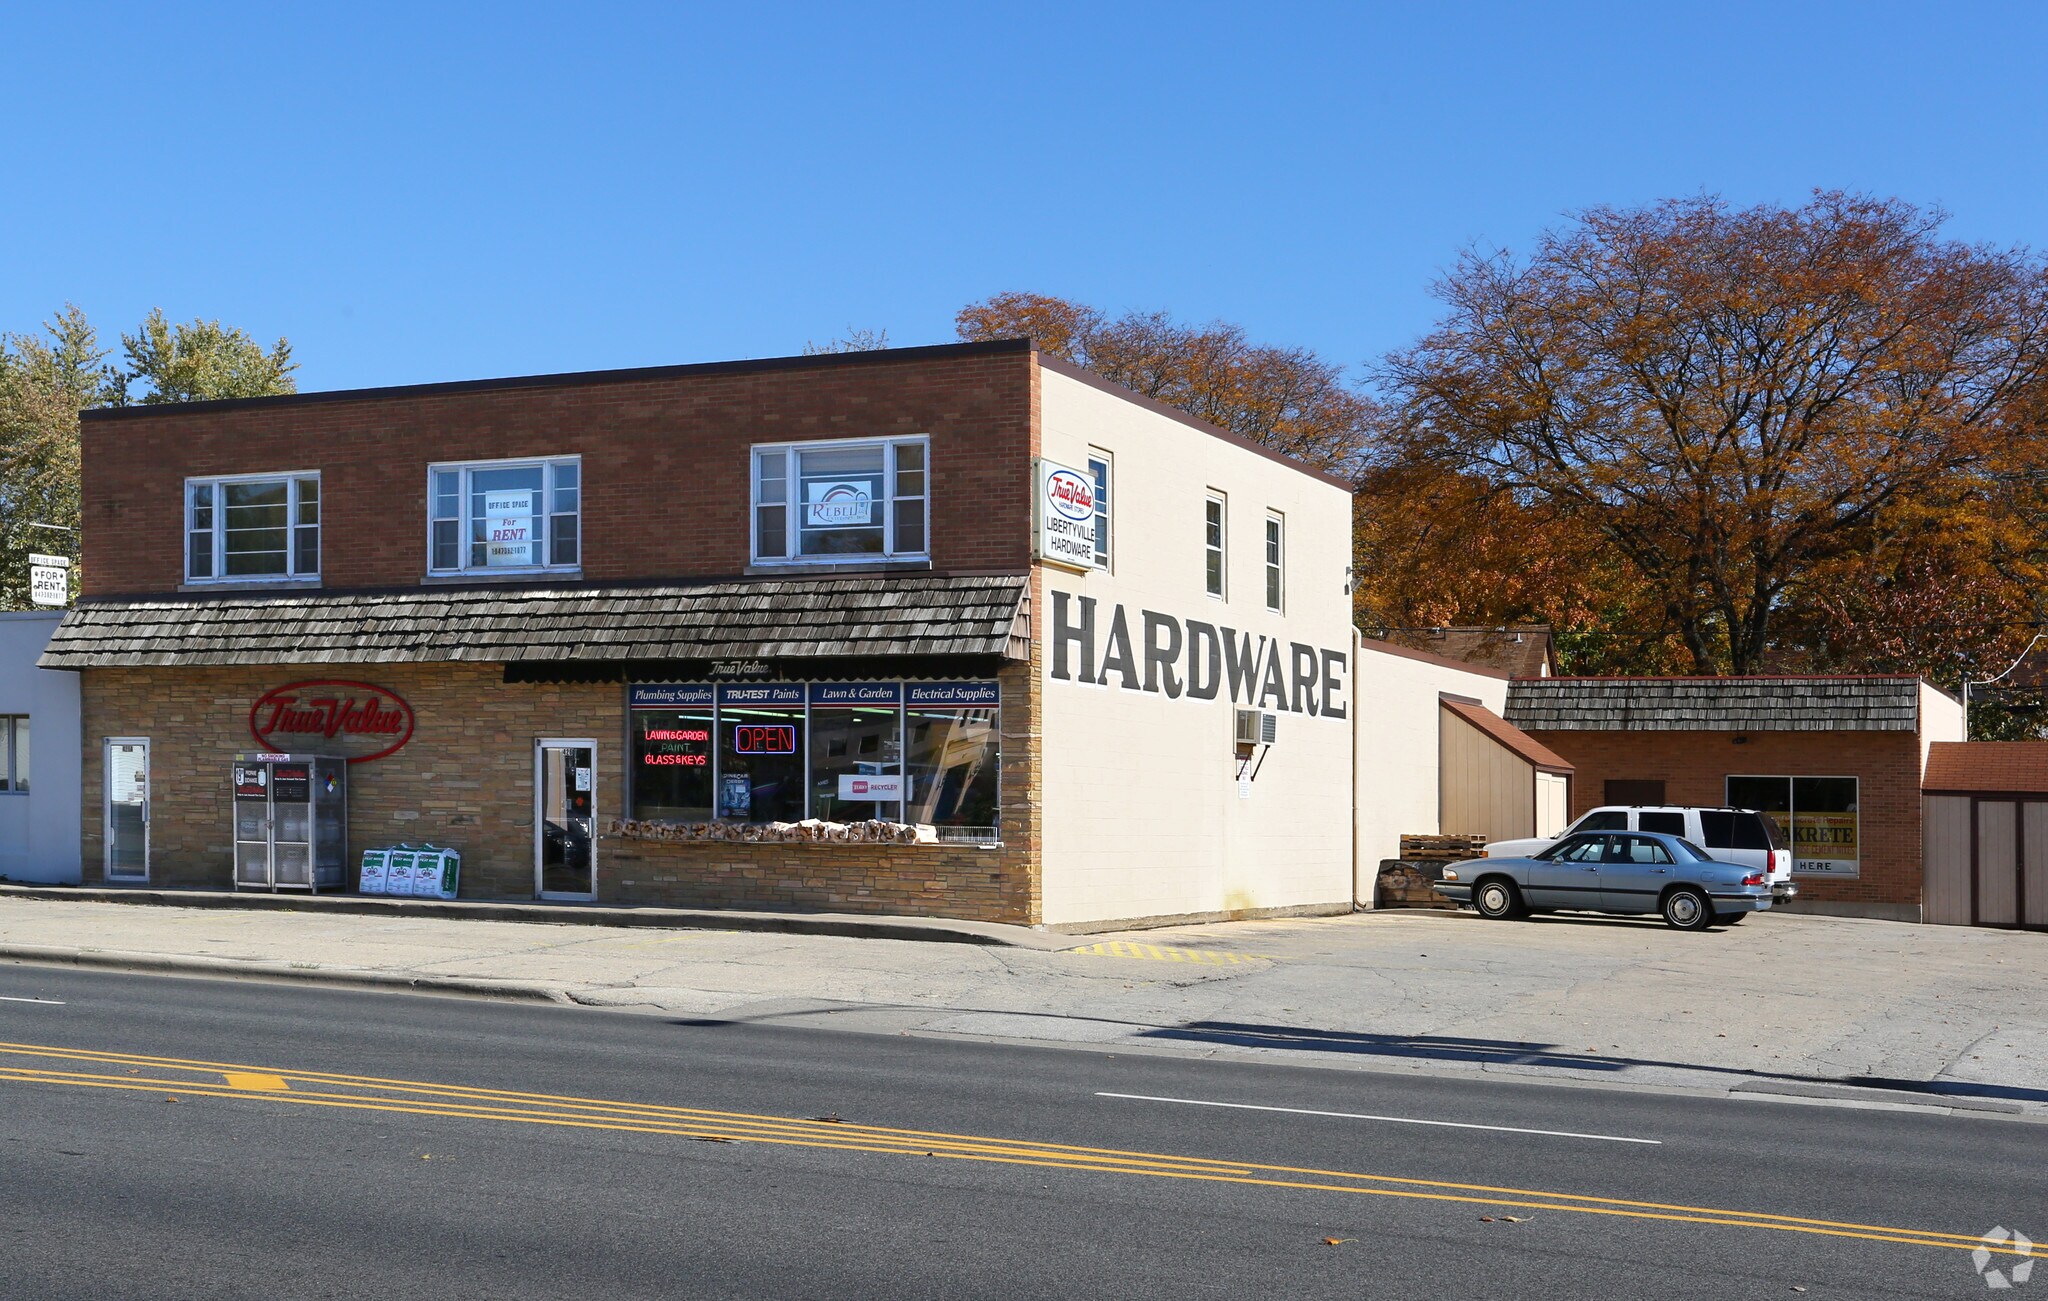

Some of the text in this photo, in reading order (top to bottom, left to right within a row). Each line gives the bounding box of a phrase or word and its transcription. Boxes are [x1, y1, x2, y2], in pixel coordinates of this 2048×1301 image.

[1046, 515, 1095, 542] LIBERTYVILLE
[492, 529, 526, 541] RENT
[1051, 535, 1091, 559] HARDWARE
[40, 571, 58, 580] FOR
[37, 581, 60, 591] RENT
[1051, 589, 1347, 720] HARDWARE
[635, 690, 712, 702] Plumbing Supplies
[726, 689, 799, 699] TRU-TEST Paints
[822, 687, 893, 699] Lawn & Garden
[911, 688, 995, 701] Electrical Supplies
[737, 727, 792, 751] OPEN
[661, 743, 691, 752] PAINT
[1824, 816, 1854, 826] Repairs
[1780, 826, 1853, 843] AKRETE
[1799, 861, 1832, 871] HERE
